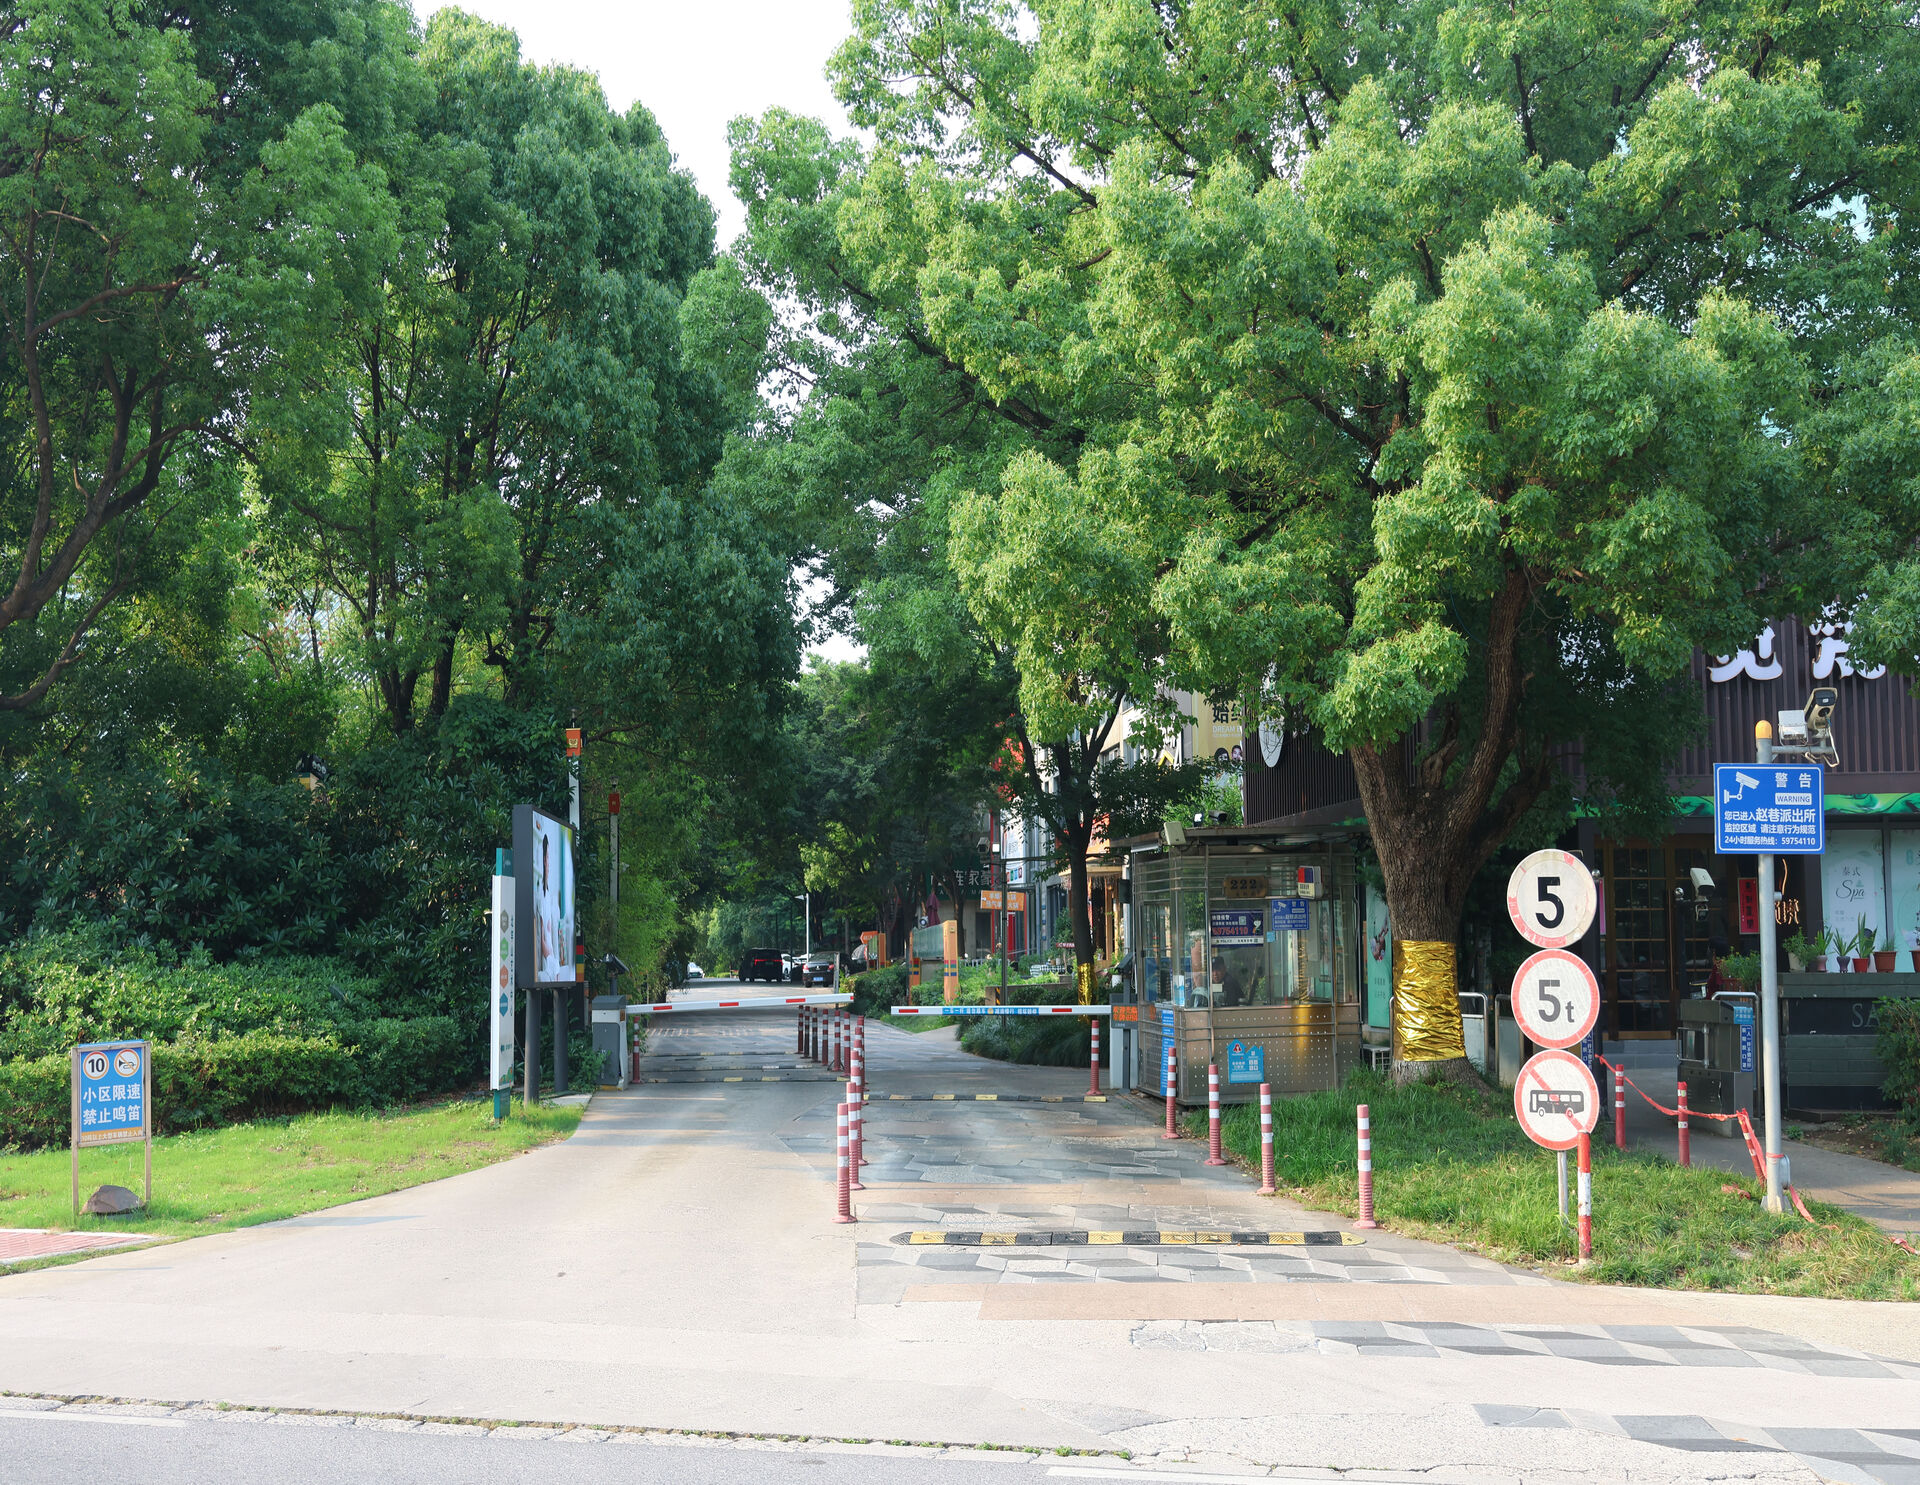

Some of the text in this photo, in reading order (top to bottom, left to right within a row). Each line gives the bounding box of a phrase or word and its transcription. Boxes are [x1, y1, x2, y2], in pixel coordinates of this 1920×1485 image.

[1775, 772, 1812, 788] 警告
[1776, 795, 1811, 803] WARNING
[1724, 807, 1816, 823] 您已进入赵巷派出所
[1724, 823, 1816, 834] 监控区域 请注意行为规范
[1835, 879, 1865, 902] Spa
[1535, 876, 1565, 928] 5
[88, 1057, 105, 1073] 10
[82, 1082, 141, 1104] 小区限速
[82, 1104, 141, 1126] 禁止鸣笛
